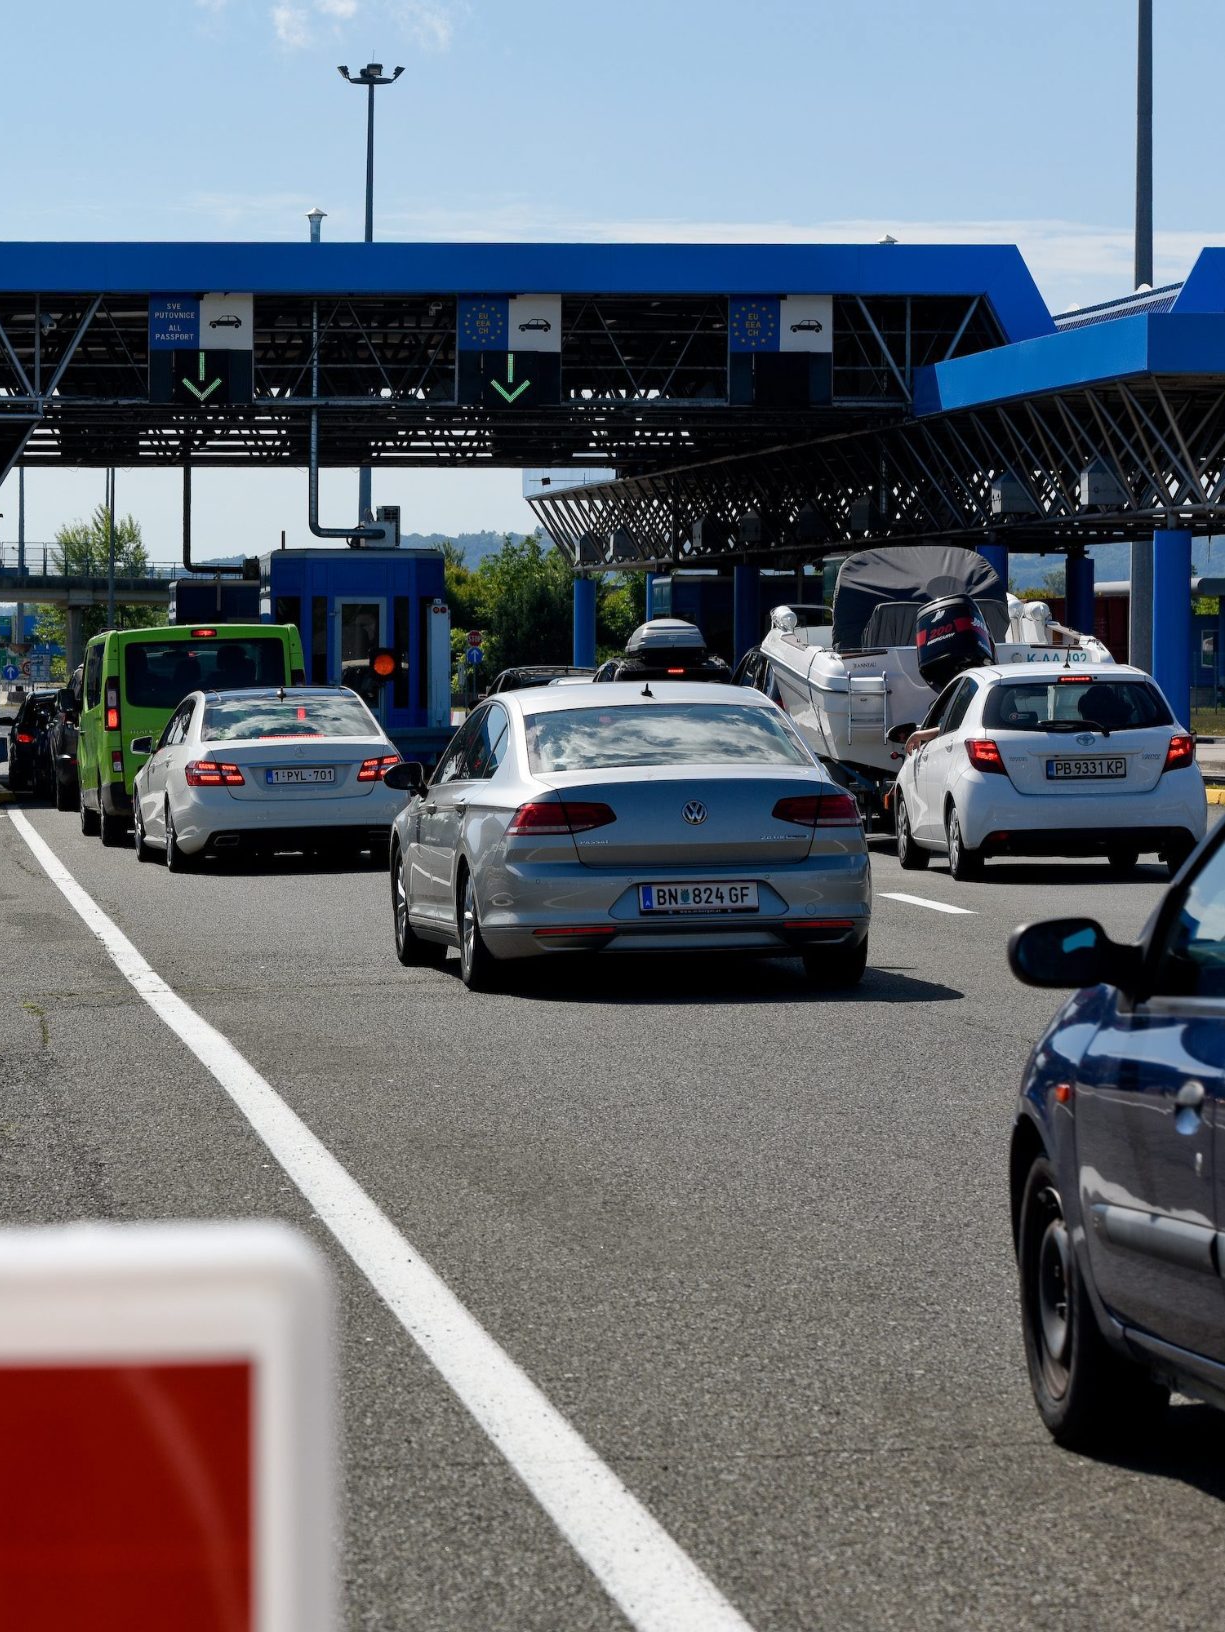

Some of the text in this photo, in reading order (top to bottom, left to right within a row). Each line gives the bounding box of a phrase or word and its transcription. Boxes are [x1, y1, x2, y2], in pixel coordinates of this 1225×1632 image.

[745, 321, 761, 329] EEA
[155, 333, 195, 341] PASSPORT
[747, 329, 759, 337] CH
[929, 623, 953, 639] 200
[1055, 760, 1124, 775] PB 9331 KP
[656, 886, 750, 906] BN 824 GF
